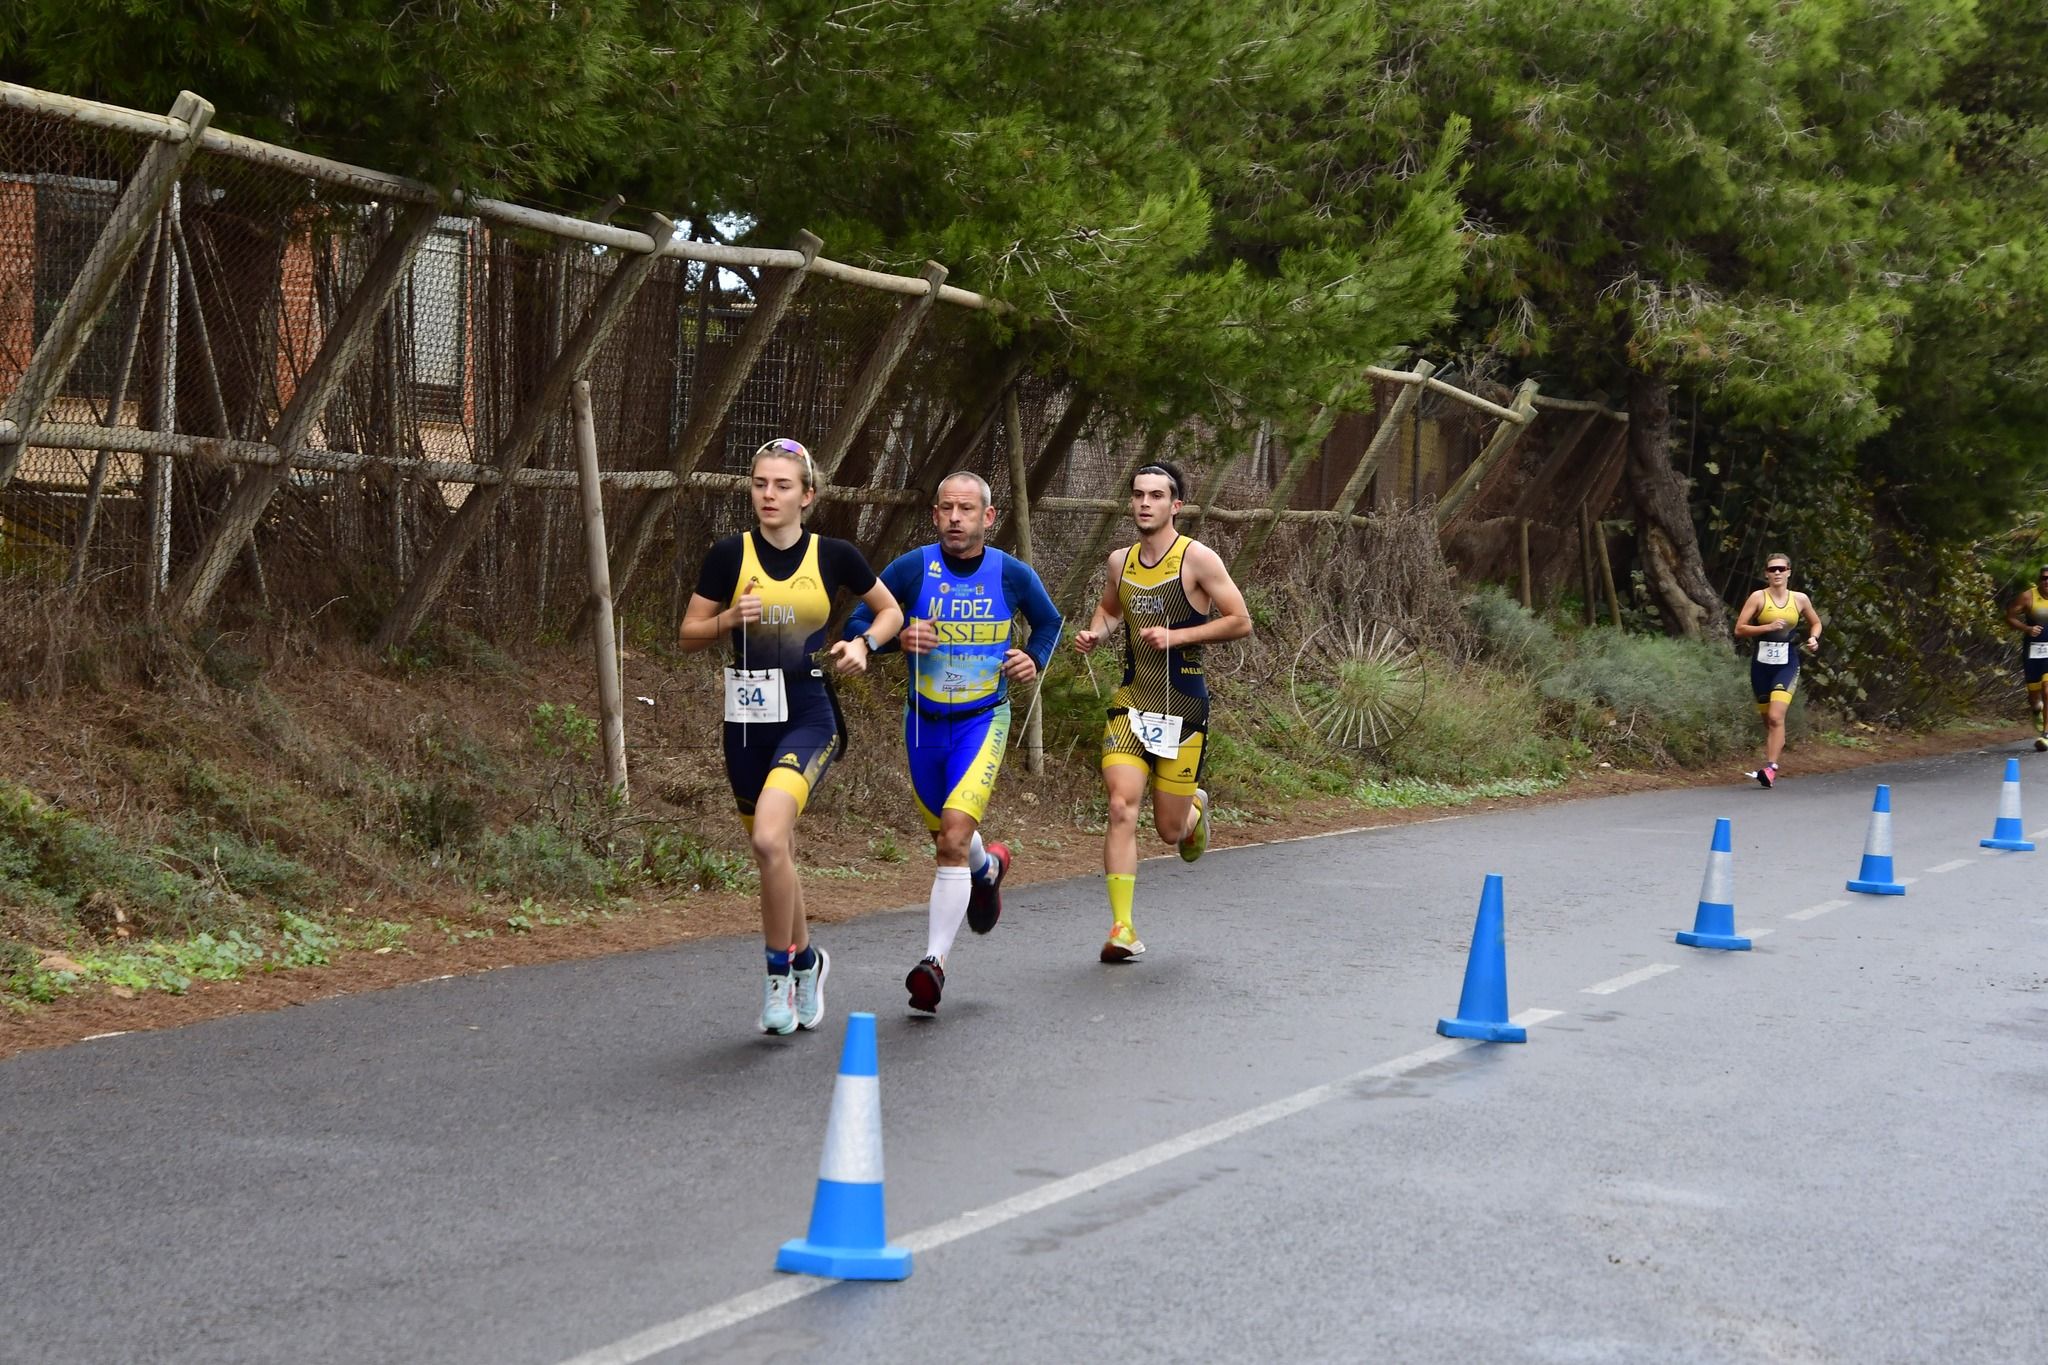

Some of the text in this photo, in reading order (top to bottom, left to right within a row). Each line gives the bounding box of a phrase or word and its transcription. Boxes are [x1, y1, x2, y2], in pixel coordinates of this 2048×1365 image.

[760, 604, 796, 625] LIDIA
[928, 596, 995, 619] M. FDEZ
[1130, 595, 1164, 614] CERDAN
[1766, 648, 1780, 658] 31
[737, 687, 765, 707] 34
[1139, 725, 1163, 744] 12
[981, 728, 1004, 789] SAN JUAN
